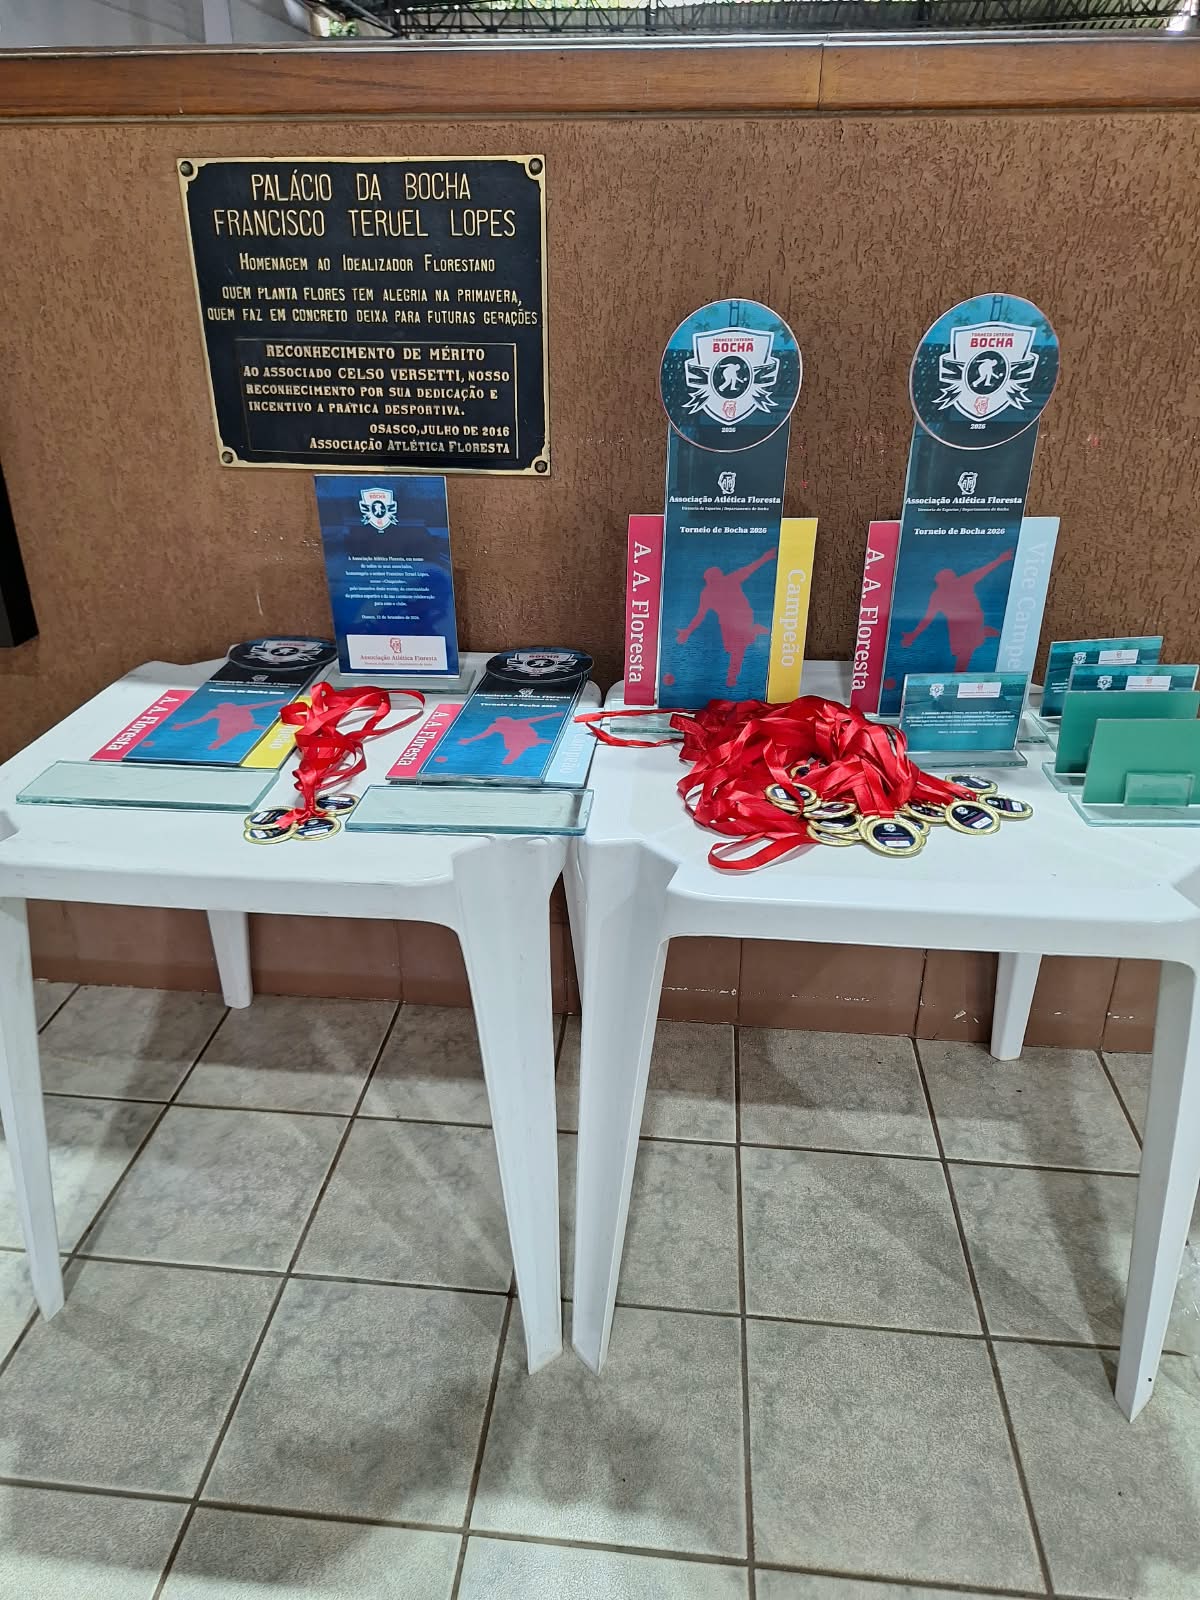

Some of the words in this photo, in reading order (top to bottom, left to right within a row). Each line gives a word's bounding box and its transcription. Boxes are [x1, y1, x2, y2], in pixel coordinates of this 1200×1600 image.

[251, 169, 333, 201] PALÁCIO
[356, 172, 382, 201] DA
[404, 172, 471, 201] BOCHA
[213, 209, 326, 237] FRANCISCO
[347, 209, 429, 237] TERUEL
[450, 209, 516, 237] LOPES
[222, 286, 252, 300] QUEM
[257, 287, 298, 301] PLANTA
[303, 287, 346, 301] FLORES
[352, 288, 374, 301] TEM
[383, 288, 428, 302] ALEGRIA
[435, 289, 450, 302] NA
[457, 289, 522, 307] PRIMAVERA,
[207, 307, 235, 321] QUEM
[242, 308, 263, 322] FAZ
[270, 308, 286, 322] EM
[292, 309, 348, 323] CONCRETO
[356, 309, 388, 323] DEIXA
[394, 310, 421, 323] PARA
[427, 310, 476, 325] FUTURAS
[483, 308, 538, 327] GERAÇÕES
[266, 344, 396, 360] RECONHECIMENTO
[403, 348, 422, 360] DE
[429, 345, 486, 361] MÉRITO
[713, 343, 754, 352] BOCHA
[970, 338, 1013, 348] BOCHA
[243, 365, 260, 377] AO
[263, 366, 332, 379] ASSOCIADO
[338, 367, 385, 380] CELSO
[390, 368, 465, 383] VERSETTI,
[468, 370, 510, 382] NOSSO
[246, 383, 356, 397] RECONHECIMENTO
[360, 386, 384, 397] POR
[389, 387, 412, 398] SUA
[416, 384, 485, 402] DEDICAÇÃO
[490, 389, 499, 400] E
[248, 401, 312, 412] INCENTIVO
[317, 403, 325, 413] A
[384, 404, 466, 416] DESPORTIVA.
[463, 426, 479, 436] DE
[482, 426, 510, 437] 2016
[309, 437, 383, 453] ASSOCIAÇÃO
[387, 439, 446, 452] ATLÉTICA
[448, 441, 511, 454] FLORESTA
[669, 495, 712, 504] Associação
[714, 495, 746, 503] Atlética
[748, 496, 781, 504] Floresta
[906, 496, 951, 505] Associação
[952, 496, 985, 504] Atlética
[988, 496, 1022, 504] Floresta
[724, 526, 748, 534] Bocha
[914, 527, 946, 535] Torneio
[948, 527, 958, 535] de
[960, 527, 985, 535] Bocha
[634, 541, 652, 564] A.
[865, 547, 885, 570] A.
[1022, 543, 1047, 590] Vice
[633, 570, 651, 592] A.
[861, 576, 881, 599] A.
[779, 568, 806, 667] Campeão
[628, 599, 650, 683] Floresta
[1007, 596, 1037, 670] Campe
[852, 605, 879, 690] Floresta
[158, 696, 180, 704] A.
[147, 705, 169, 715] A.
[431, 711, 450, 719] A.
[105, 715, 160, 751] Floresta
[424, 721, 443, 730] A.
[396, 730, 437, 766] Floresta
